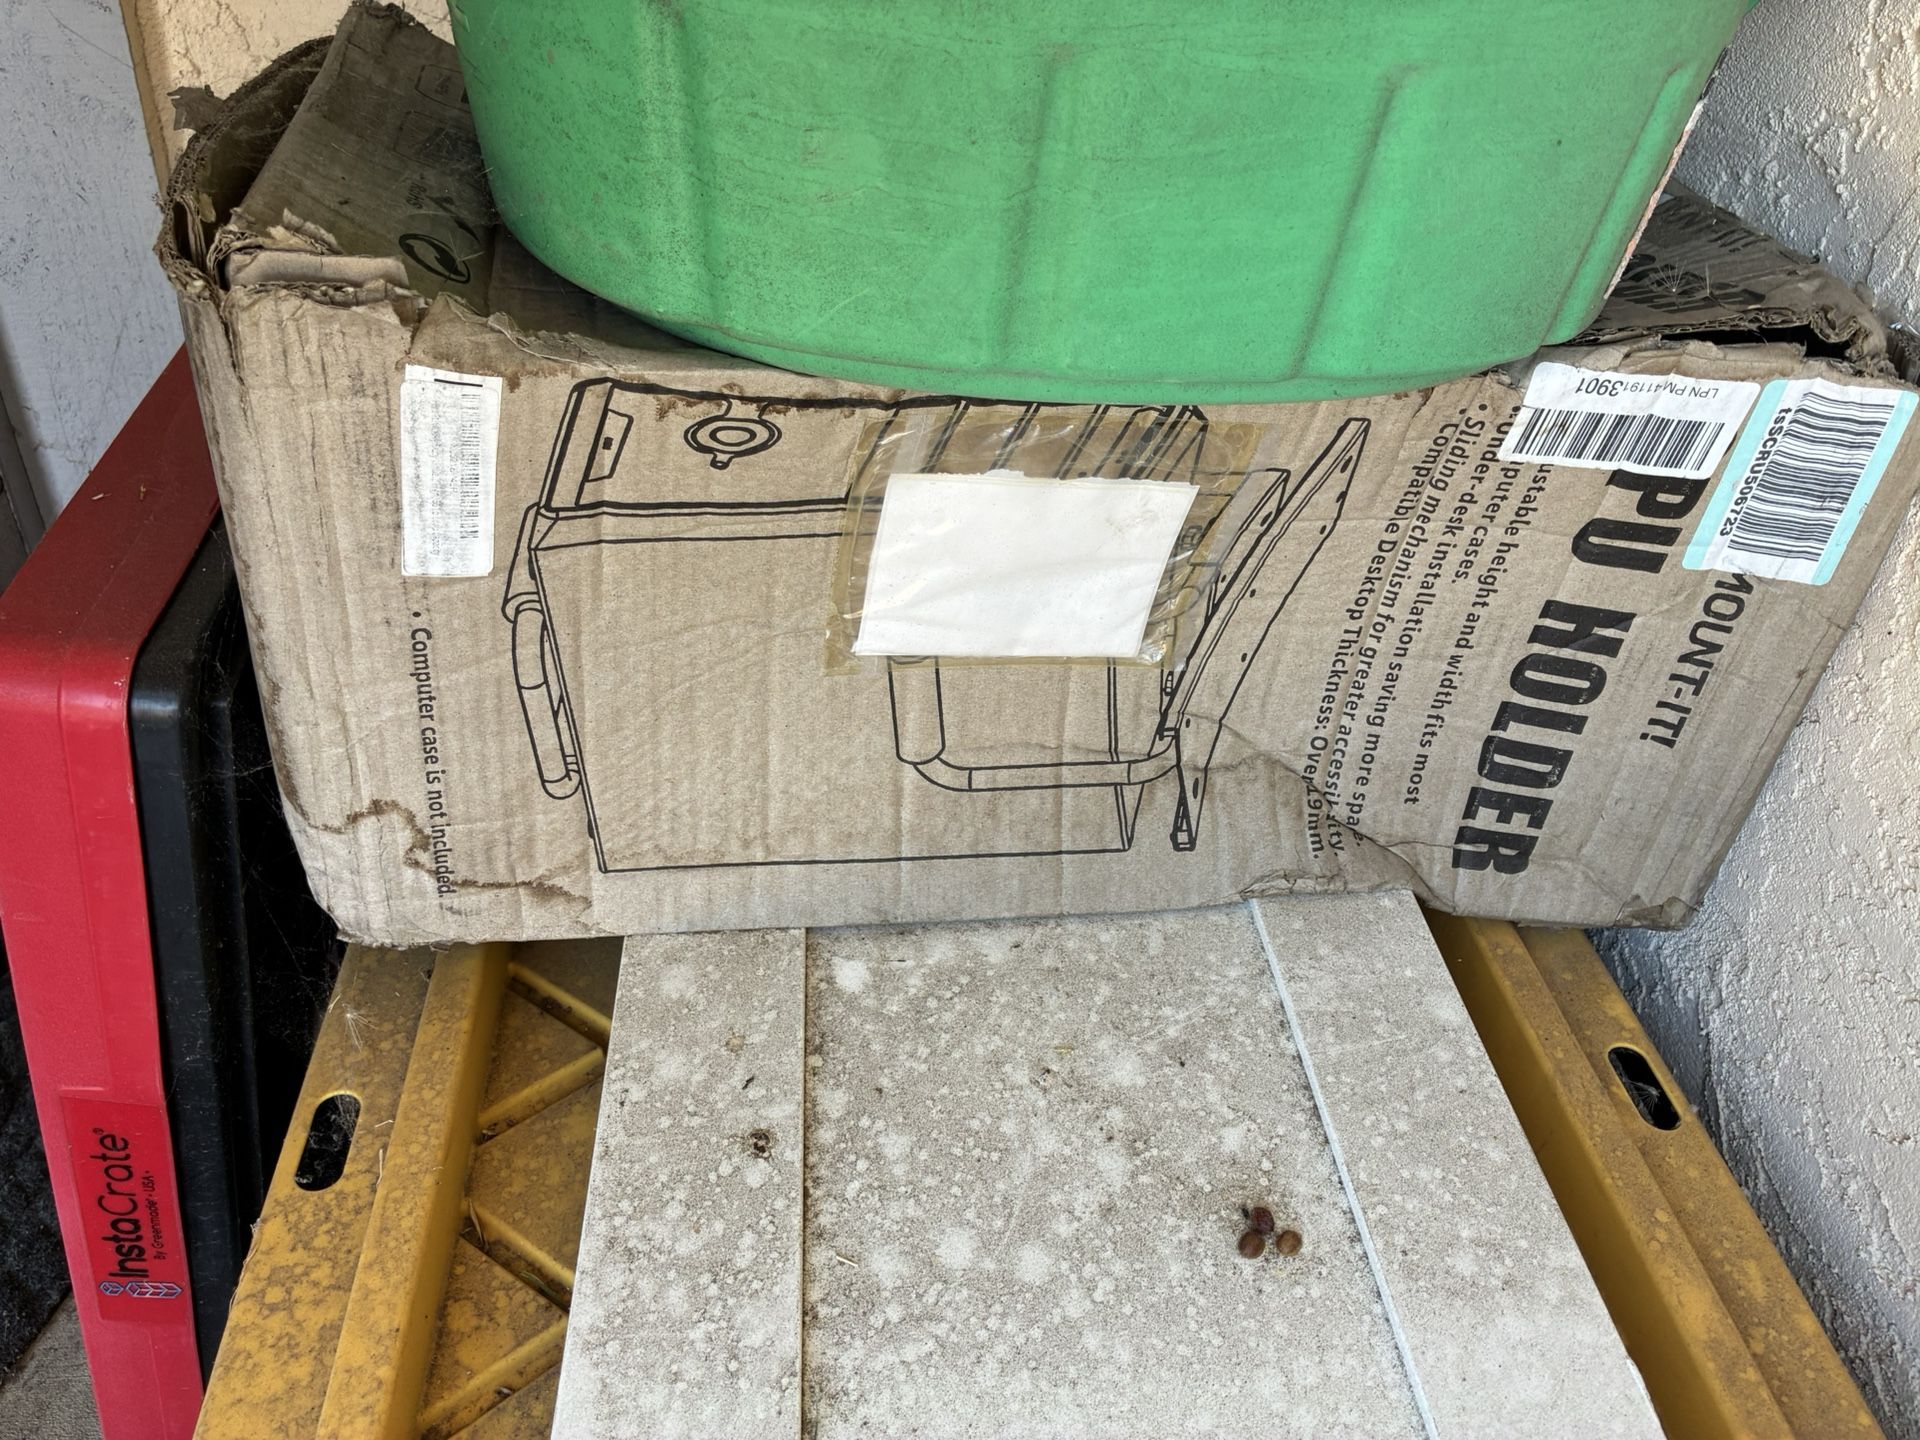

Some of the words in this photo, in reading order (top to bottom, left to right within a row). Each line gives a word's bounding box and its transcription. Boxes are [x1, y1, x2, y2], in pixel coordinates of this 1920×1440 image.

[1688, 384, 1719, 400] LPN
[1385, 423, 1460, 535] Compatible
[1429, 416, 1486, 492] Sliding
[1717, 407, 1792, 540] tsSCRU506723
[1482, 461, 1525, 524] puter
[1504, 464, 1554, 536] ustable
[1570, 470, 1711, 573] PU
[1346, 539, 1399, 622] Desktop
[1381, 494, 1441, 610] mechanism
[1451, 526, 1489, 584] cases.
[1471, 541, 1519, 609] height
[1369, 613, 1395, 643] for
[1393, 541, 1457, 658] installation
[1455, 613, 1482, 650] and
[409, 626, 437, 722] Computer
[1313, 627, 1363, 731] Thickness:
[1342, 646, 1378, 721] greater
[1431, 654, 1464, 711] width
[1639, 572, 1755, 748] MOUNT-IT!
[1366, 661, 1403, 729] saving
[421, 726, 440, 765] case
[1301, 736, 1329, 785] Over
[1357, 733, 1381, 787] more
[1420, 713, 1445, 748] fits
[1451, 599, 1639, 875] HOLDER
[425, 769, 446, 784] is
[428, 789, 449, 819] not
[1403, 753, 1429, 805] most
[1305, 783, 1326, 860] 19mm.
[1346, 791, 1367, 847] spae.
[431, 823, 457, 899] included.
[142, 1175, 156, 1193] USA
[153, 1251, 167, 1260] By
